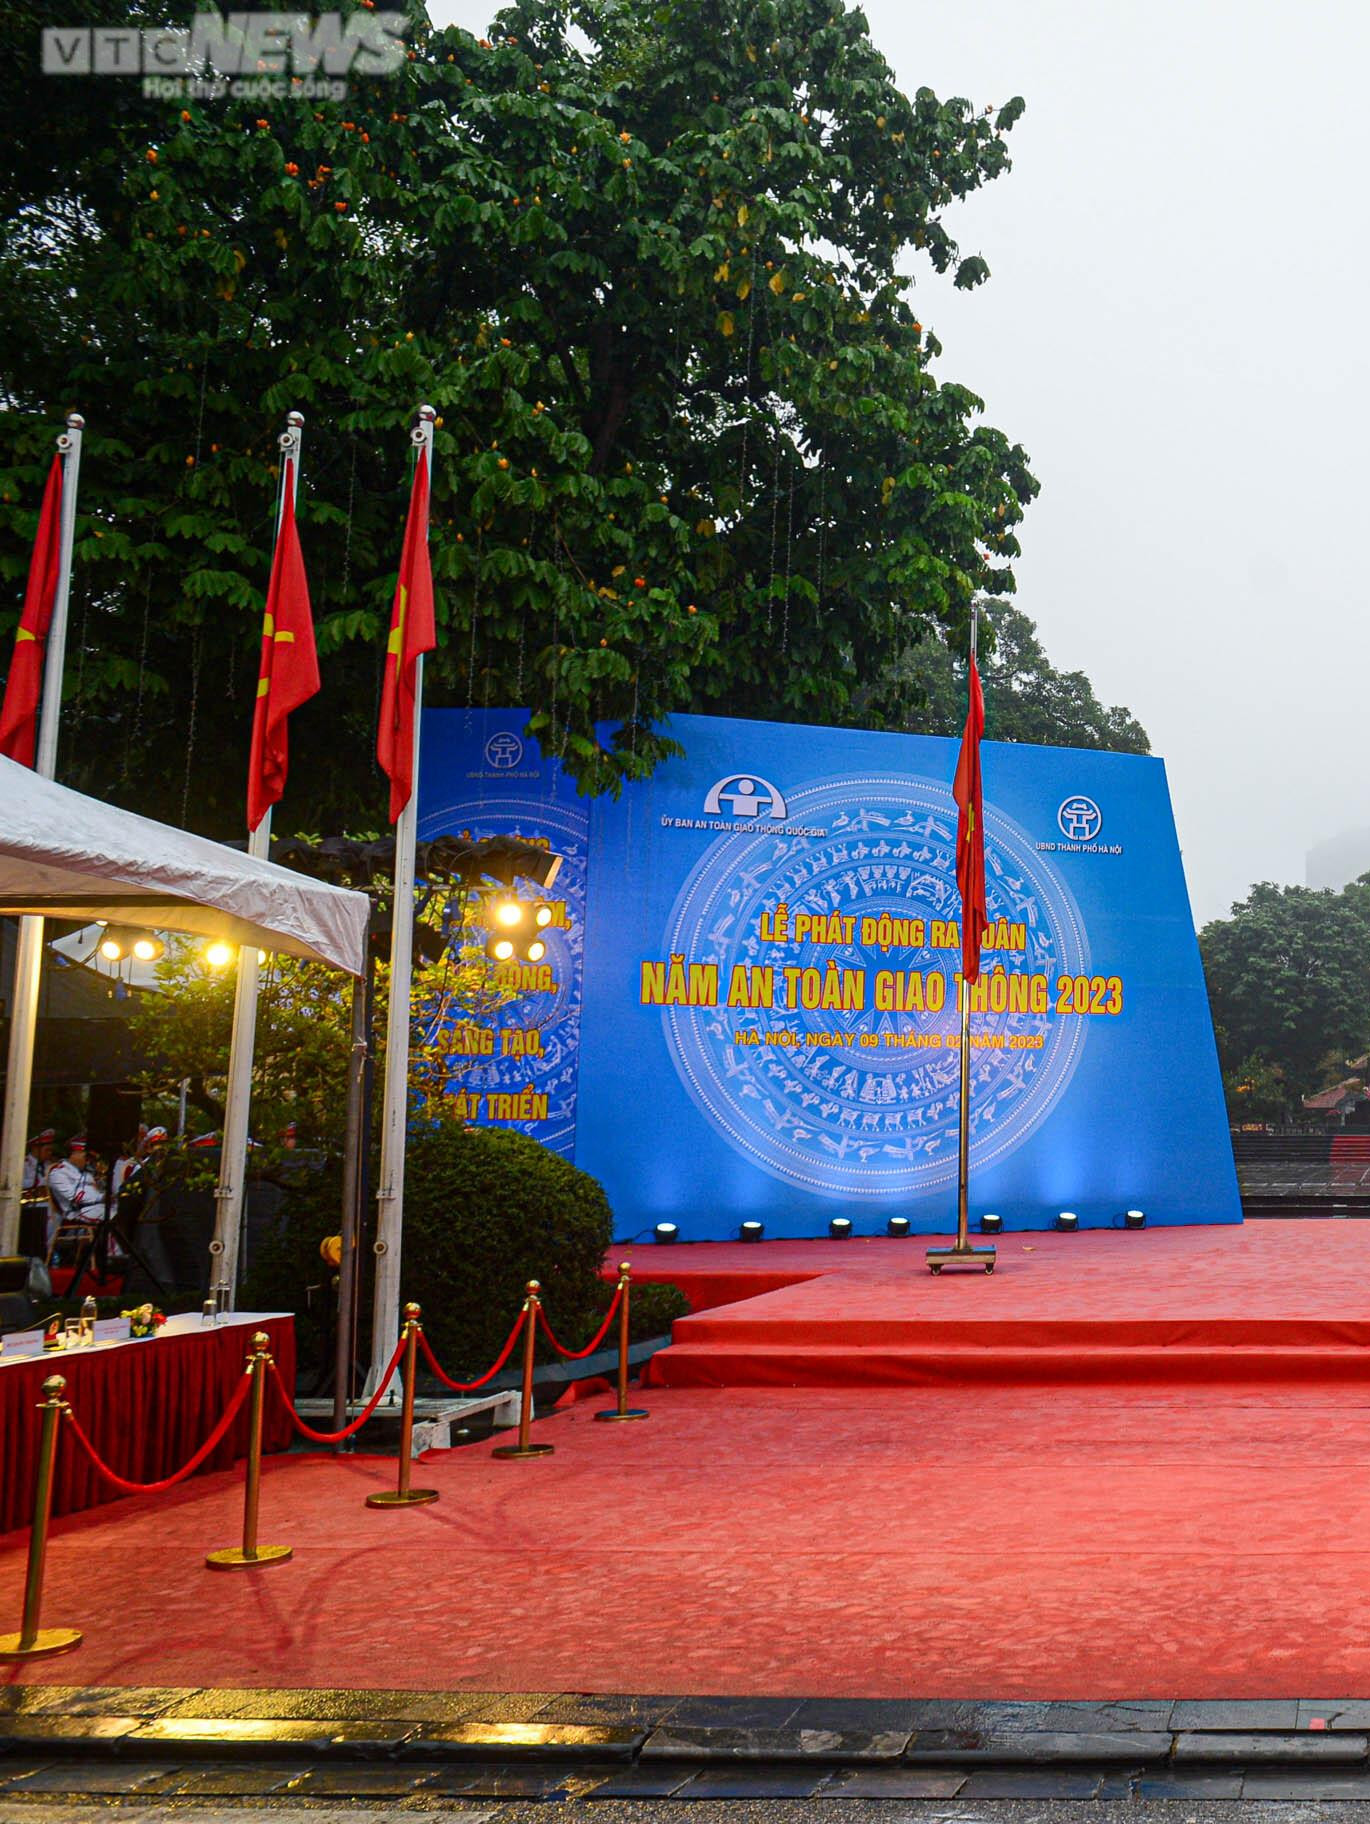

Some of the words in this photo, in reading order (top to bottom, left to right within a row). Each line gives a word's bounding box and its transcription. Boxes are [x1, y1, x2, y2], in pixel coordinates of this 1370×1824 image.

[661, 814, 673, 827] ỦY
[675, 818, 694, 829] BAN
[695, 819, 708, 829] AN
[709, 819, 732, 831] TOÀN
[733, 822, 753, 833] GIAO
[786, 823, 809, 837] QUỐC
[809, 827, 826, 837] GIA
[1035, 842, 1056, 851] UBND
[1057, 842, 1081, 853] THÀNH
[1082, 841, 1098, 853] PHỐ
[1098, 844, 1109, 854] HÀ
[1110, 844, 1122, 855] NỘI
[760, 903, 788, 942] LỄ
[795, 910, 856, 945] PHÁT
[861, 913, 925, 952] ĐỘNG
[931, 920, 960, 948] RA
[981, 917, 1026, 951] UÂN
[640, 953, 718, 1007] NĂM
[728, 966, 776, 1008] AN
[783, 959, 864, 1011] TOÀN
[874, 969, 945, 1013] GIAO
[1056, 974, 1123, 1016] 2023
[501, 1028, 545, 1061] TẠO,
[734, 1029, 760, 1046] HÀ
[765, 1030, 801, 1049] NỘI,
[806, 1030, 855, 1047] NGÀY
[860, 1034, 879, 1047] 09
[884, 1030, 942, 1048] THÁNG
[969, 1030, 1004, 1049] NĂM
[1009, 1034, 1044, 1049] 2023
[486, 1083, 548, 1120] TRIỂN
